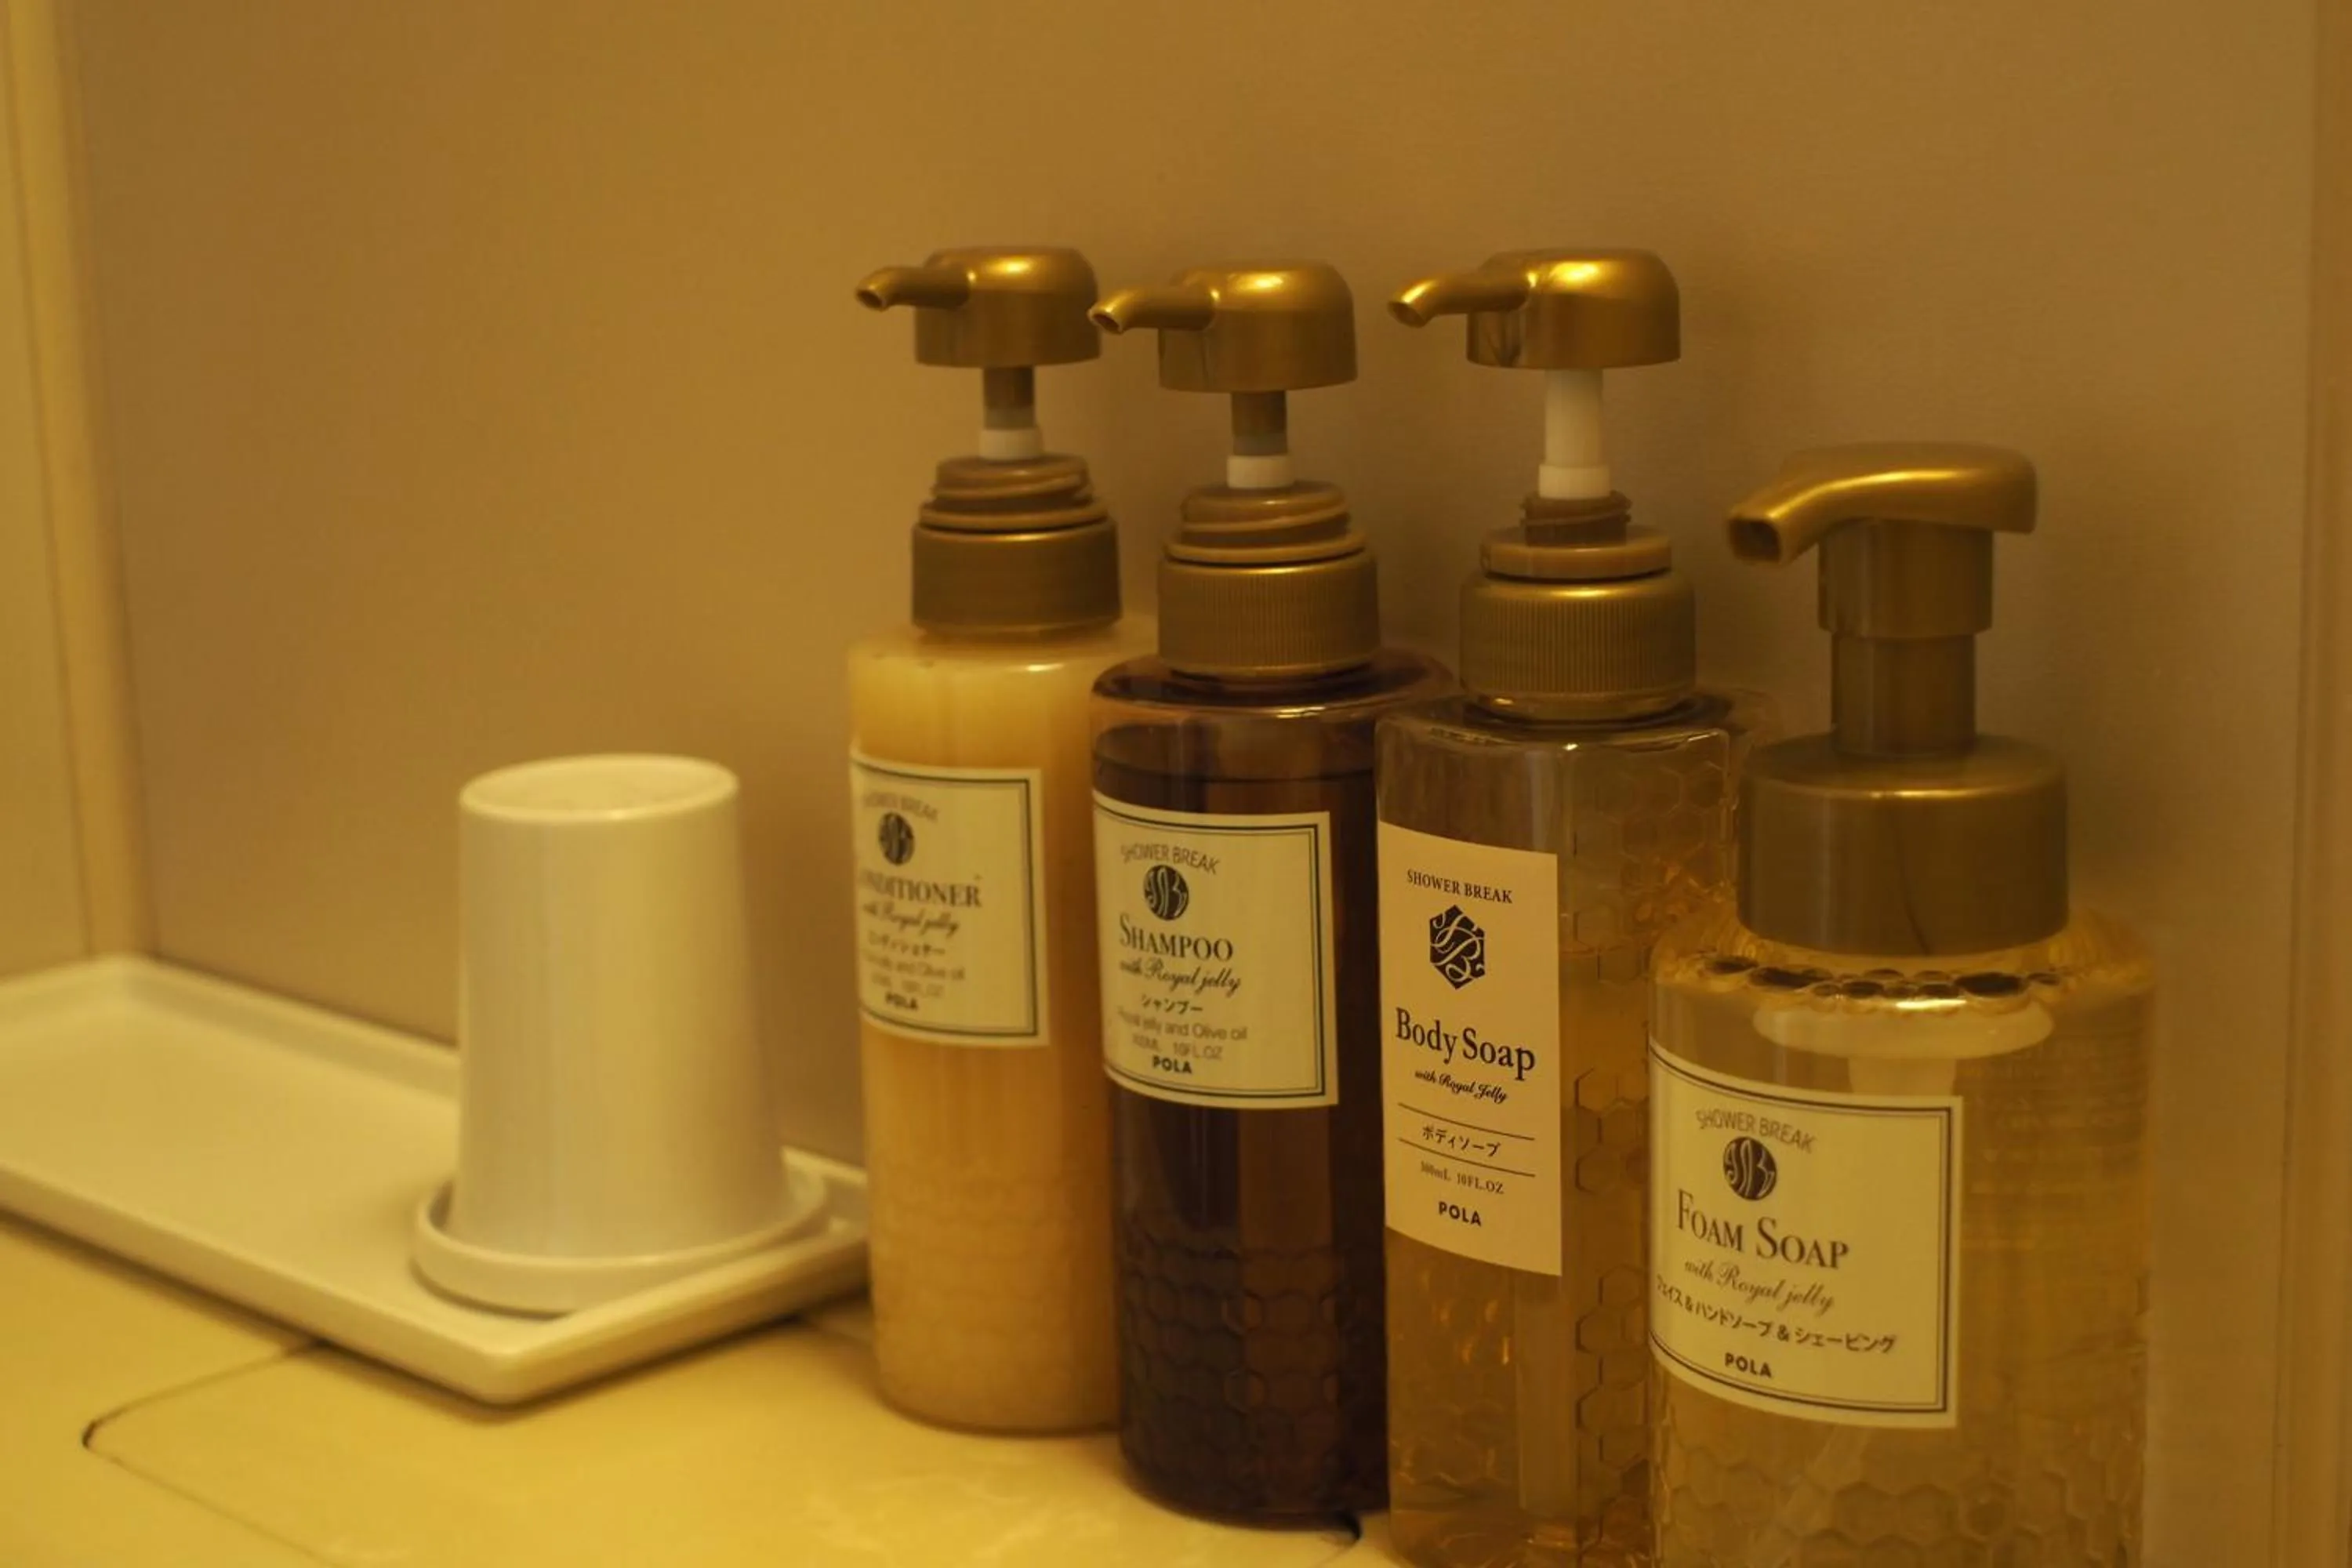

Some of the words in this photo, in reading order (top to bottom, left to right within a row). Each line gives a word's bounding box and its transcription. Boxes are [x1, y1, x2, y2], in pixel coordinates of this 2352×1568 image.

[1173, 846, 1220, 876] BREAK
[1407, 869, 1460, 895] SHOWER
[1465, 882, 1513, 904] BREAK
[1120, 912, 1233, 961] SHAMPOO
[1195, 967, 1241, 997] jelly
[1396, 1007, 1458, 1065] Body
[1462, 1027, 1536, 1081] Soap
[1152, 1054, 1192, 1074] POLA
[1414, 1070, 1437, 1084] with
[1439, 1073, 1475, 1094] Royal
[1474, 1083, 1508, 1105] Jelly
[1422, 1123, 1501, 1156] ボディソープ
[1695, 1109, 1755, 1131] SHOWER
[1759, 1118, 1817, 1153] BREAK
[1439, 1200, 1482, 1227] POLA
[1676, 1188, 1744, 1254] FOAM
[1756, 1216, 1850, 1270] SOAP
[1684, 1258, 1715, 1283] with
[1715, 1262, 1787, 1305] Royal
[1777, 1281, 1836, 1318] jelly
[1725, 1352, 1773, 1378] POLA
